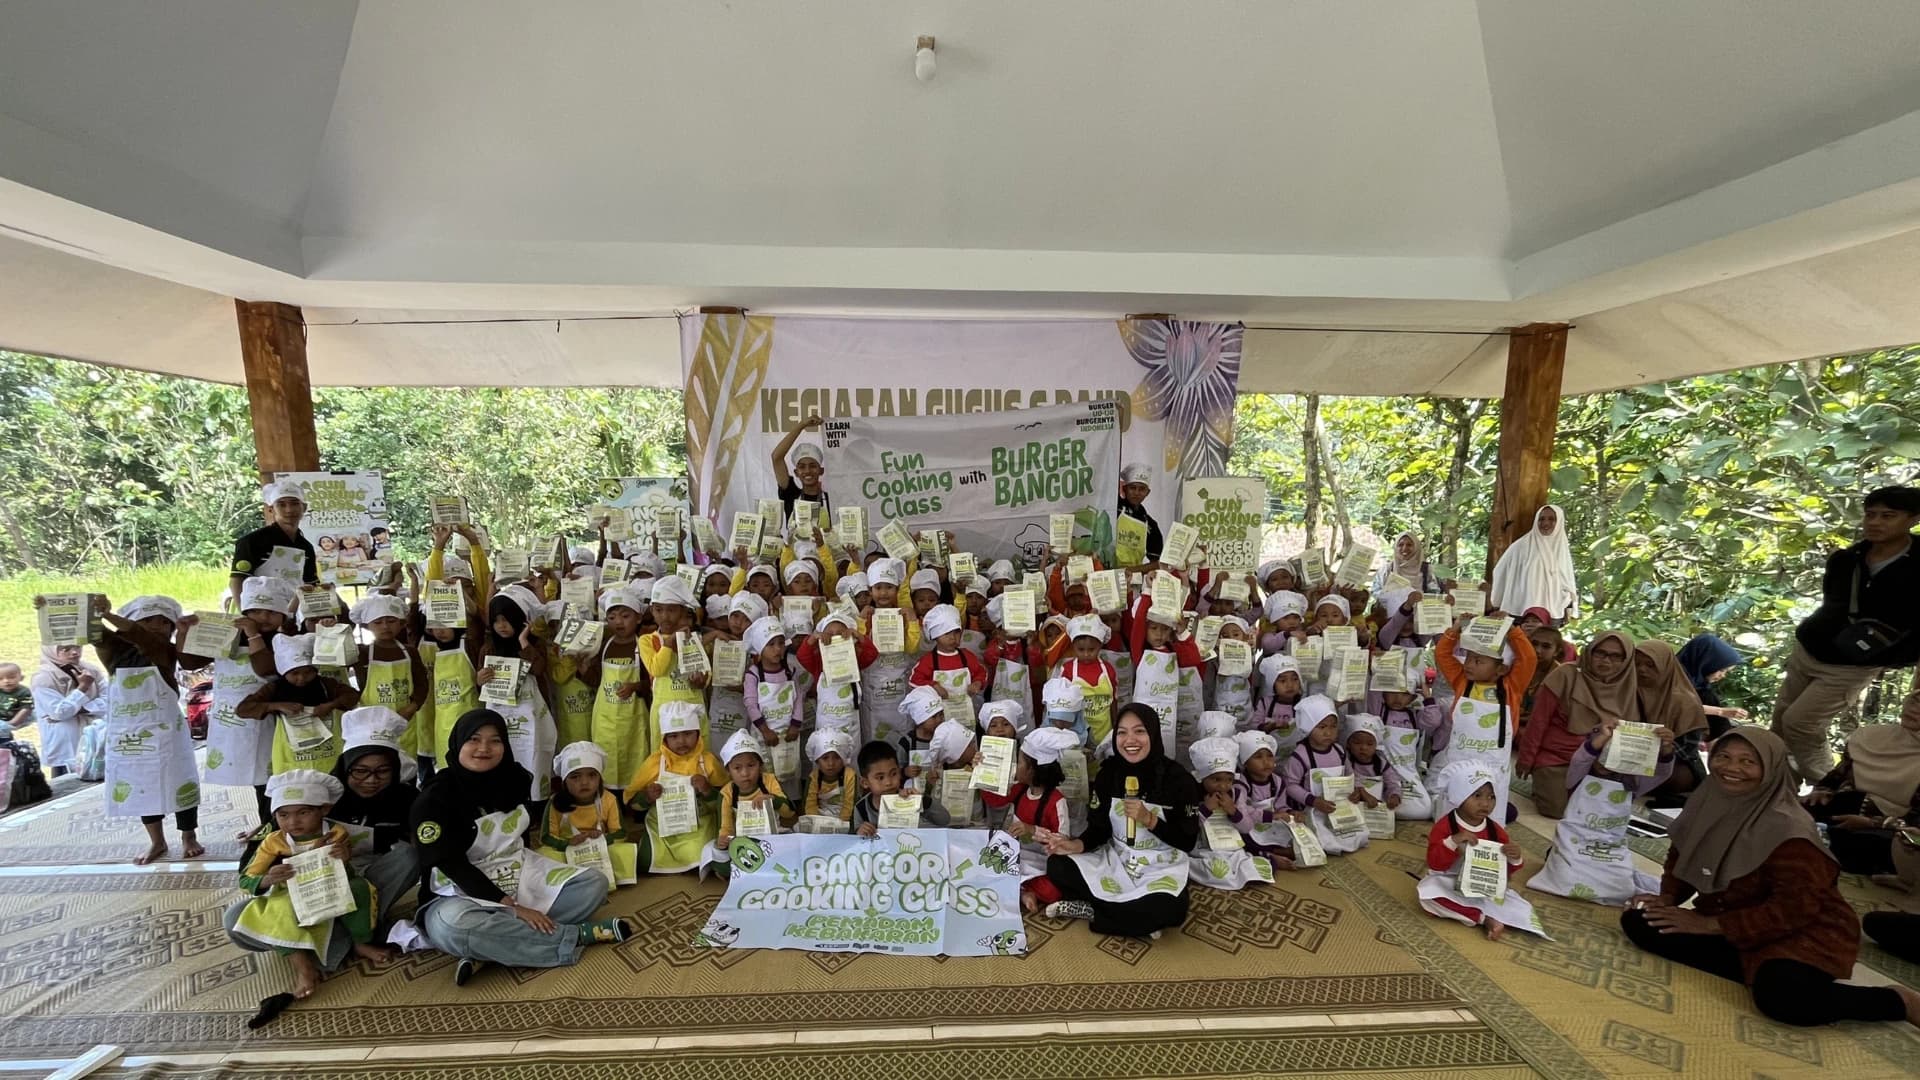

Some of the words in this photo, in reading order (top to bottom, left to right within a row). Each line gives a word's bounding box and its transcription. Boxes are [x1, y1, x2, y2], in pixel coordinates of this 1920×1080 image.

[825, 422, 850, 431] LEARN
[826, 431, 847, 440] WITH
[827, 440, 840, 449] US!
[880, 450, 925, 474] Fun
[991, 438, 1088, 477] BURGER
[862, 471, 953, 500] Cooking
[959, 470, 987, 485] with
[994, 466, 1094, 508] BANGOR
[880, 495, 943, 520] Class
[1204, 498, 1242, 513] FUN
[1183, 511, 1262, 528] COOKING
[1207, 552, 1255, 567] NGOR
[1456, 733, 1499, 753] Bango
[1473, 849, 1490, 860] THIS
[1492, 852, 1498, 861] IS
[803, 852, 945, 887] BANGOR
[737, 881, 893, 913] COOKING
[806, 915, 934, 930] PEMADAM
